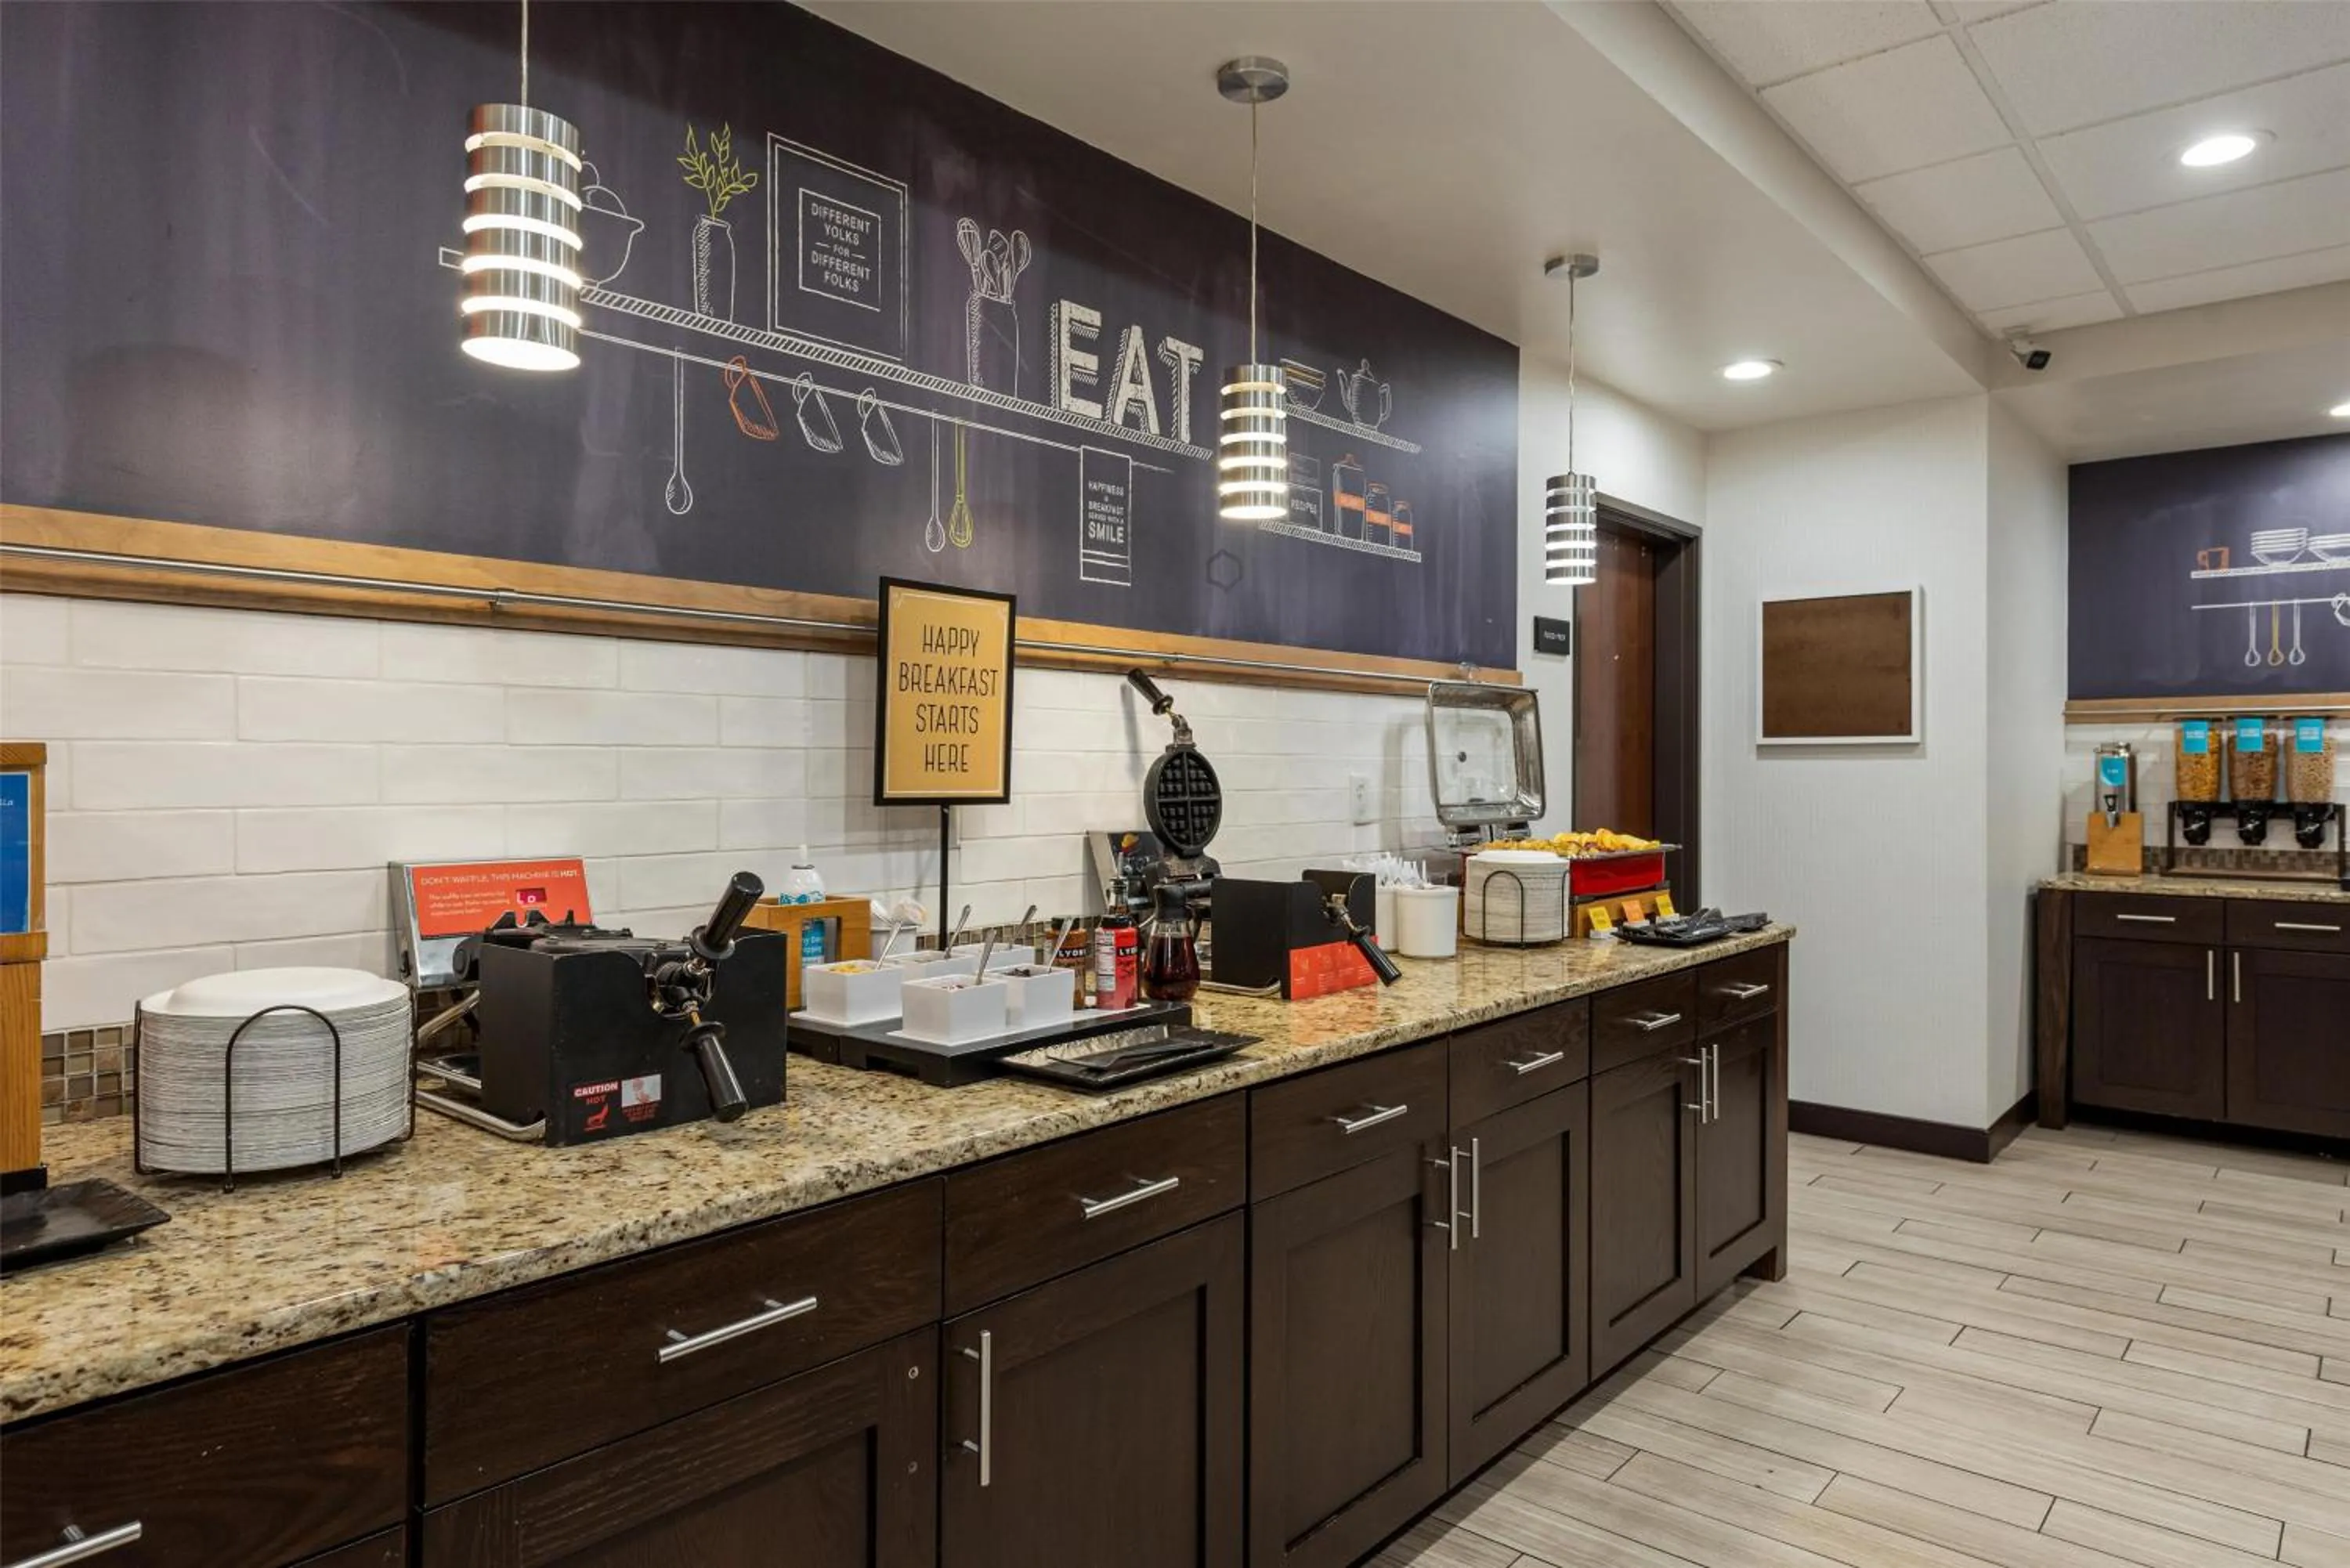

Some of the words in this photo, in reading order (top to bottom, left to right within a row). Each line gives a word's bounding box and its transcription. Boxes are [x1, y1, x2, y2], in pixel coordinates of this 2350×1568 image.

[811, 202, 871, 235] DIFFERENT
[824, 222, 859, 246] YOLKS
[833, 244, 850, 258] FOR
[811, 250, 871, 281] DIFFERENT
[824, 270, 859, 293] FOLKS
[1051, 298, 1205, 445] EAT
[1088, 480, 1124, 497] HAPPINESS
[1088, 521, 1124, 544] SMILE
[922, 623, 980, 657] HAPPY
[898, 662, 999, 696] BREAKFAST
[915, 703, 979, 734] STARTS
[924, 743, 971, 773] HERE
[574, 1082, 618, 1097] CAUTION
[586, 1095, 606, 1105] HOT
